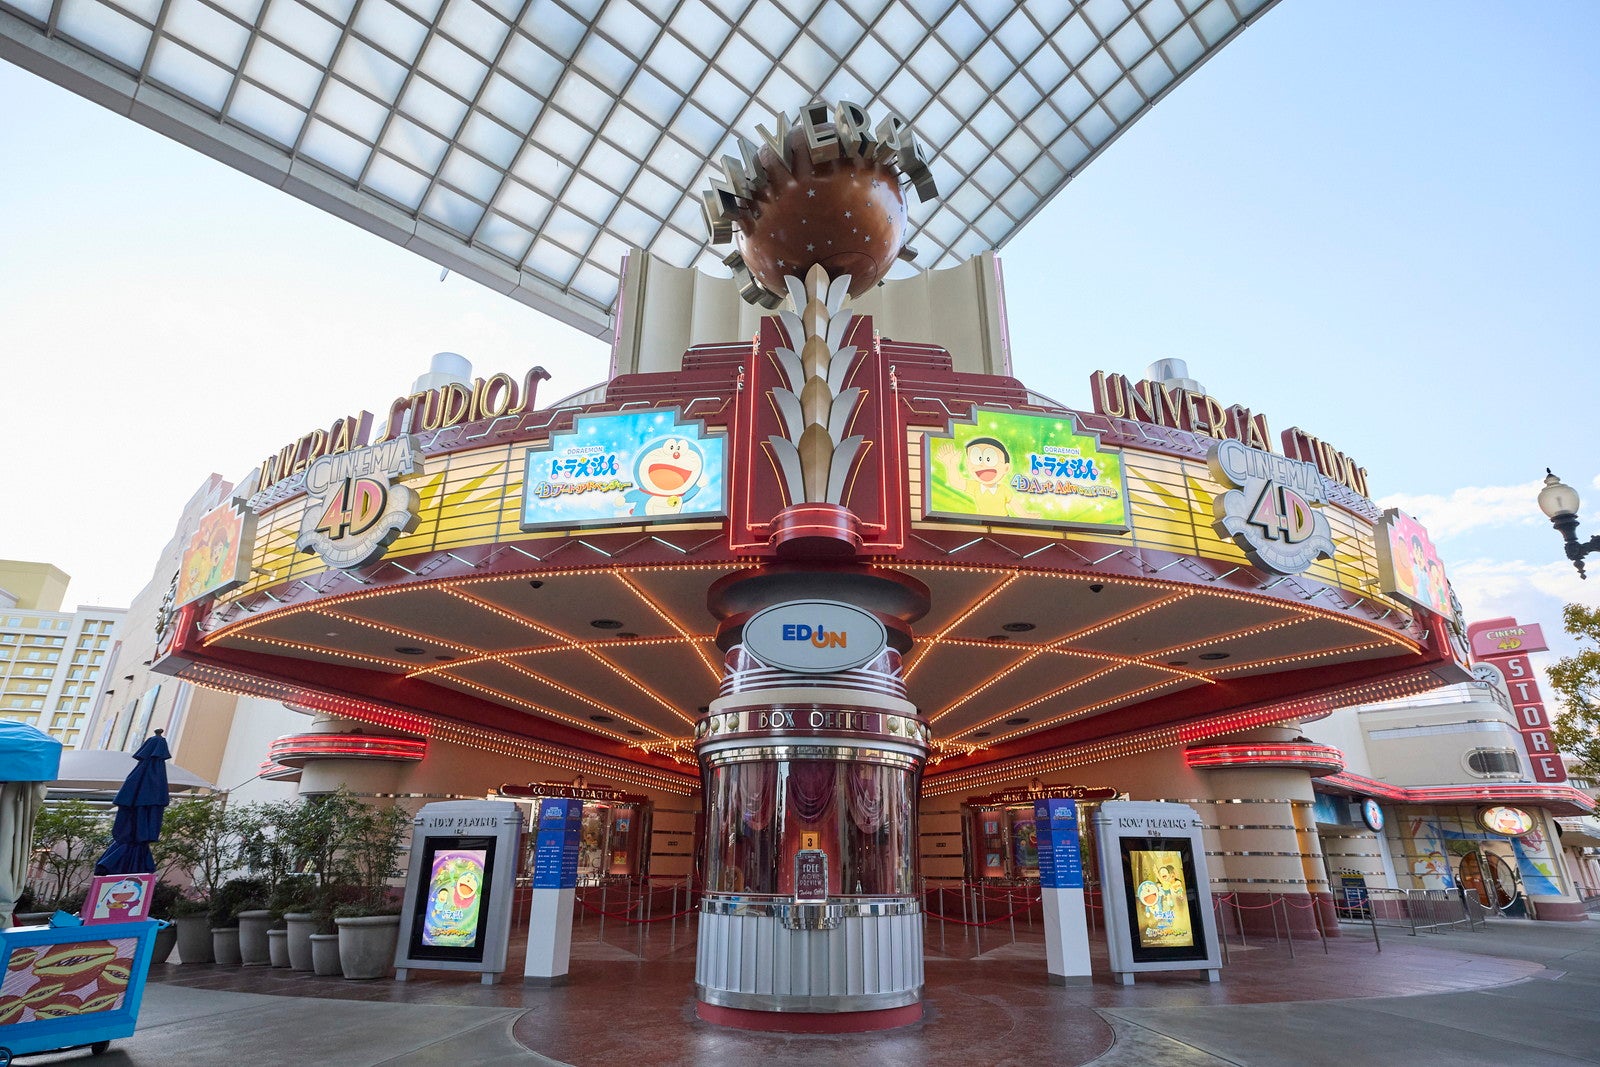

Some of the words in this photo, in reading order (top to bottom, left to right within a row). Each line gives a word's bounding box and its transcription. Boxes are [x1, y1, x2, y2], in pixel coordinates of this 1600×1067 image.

[376, 366, 552, 444] STUDIOS
[1090, 370, 1273, 452] UNIVERSAL
[567, 446, 603, 455] DORAEMON
[1044, 446, 1080, 455] DORAEMON
[306, 435, 415, 495] CINEMA
[1218, 438, 1327, 502] CINEMA
[782, 624, 847, 648] EDION
[1486, 628, 1526, 641] CINEMA
[758, 711, 796, 729] BOX
[808, 710, 870, 731] OFFICE
[1507, 658, 1558, 778] STORE
[429, 817, 454, 828] NOW
[457, 817, 498, 828] PLAYING
[1118, 817, 1144, 828] NOW
[807, 837, 813, 847] 3
[802, 863, 819, 873] FREE
